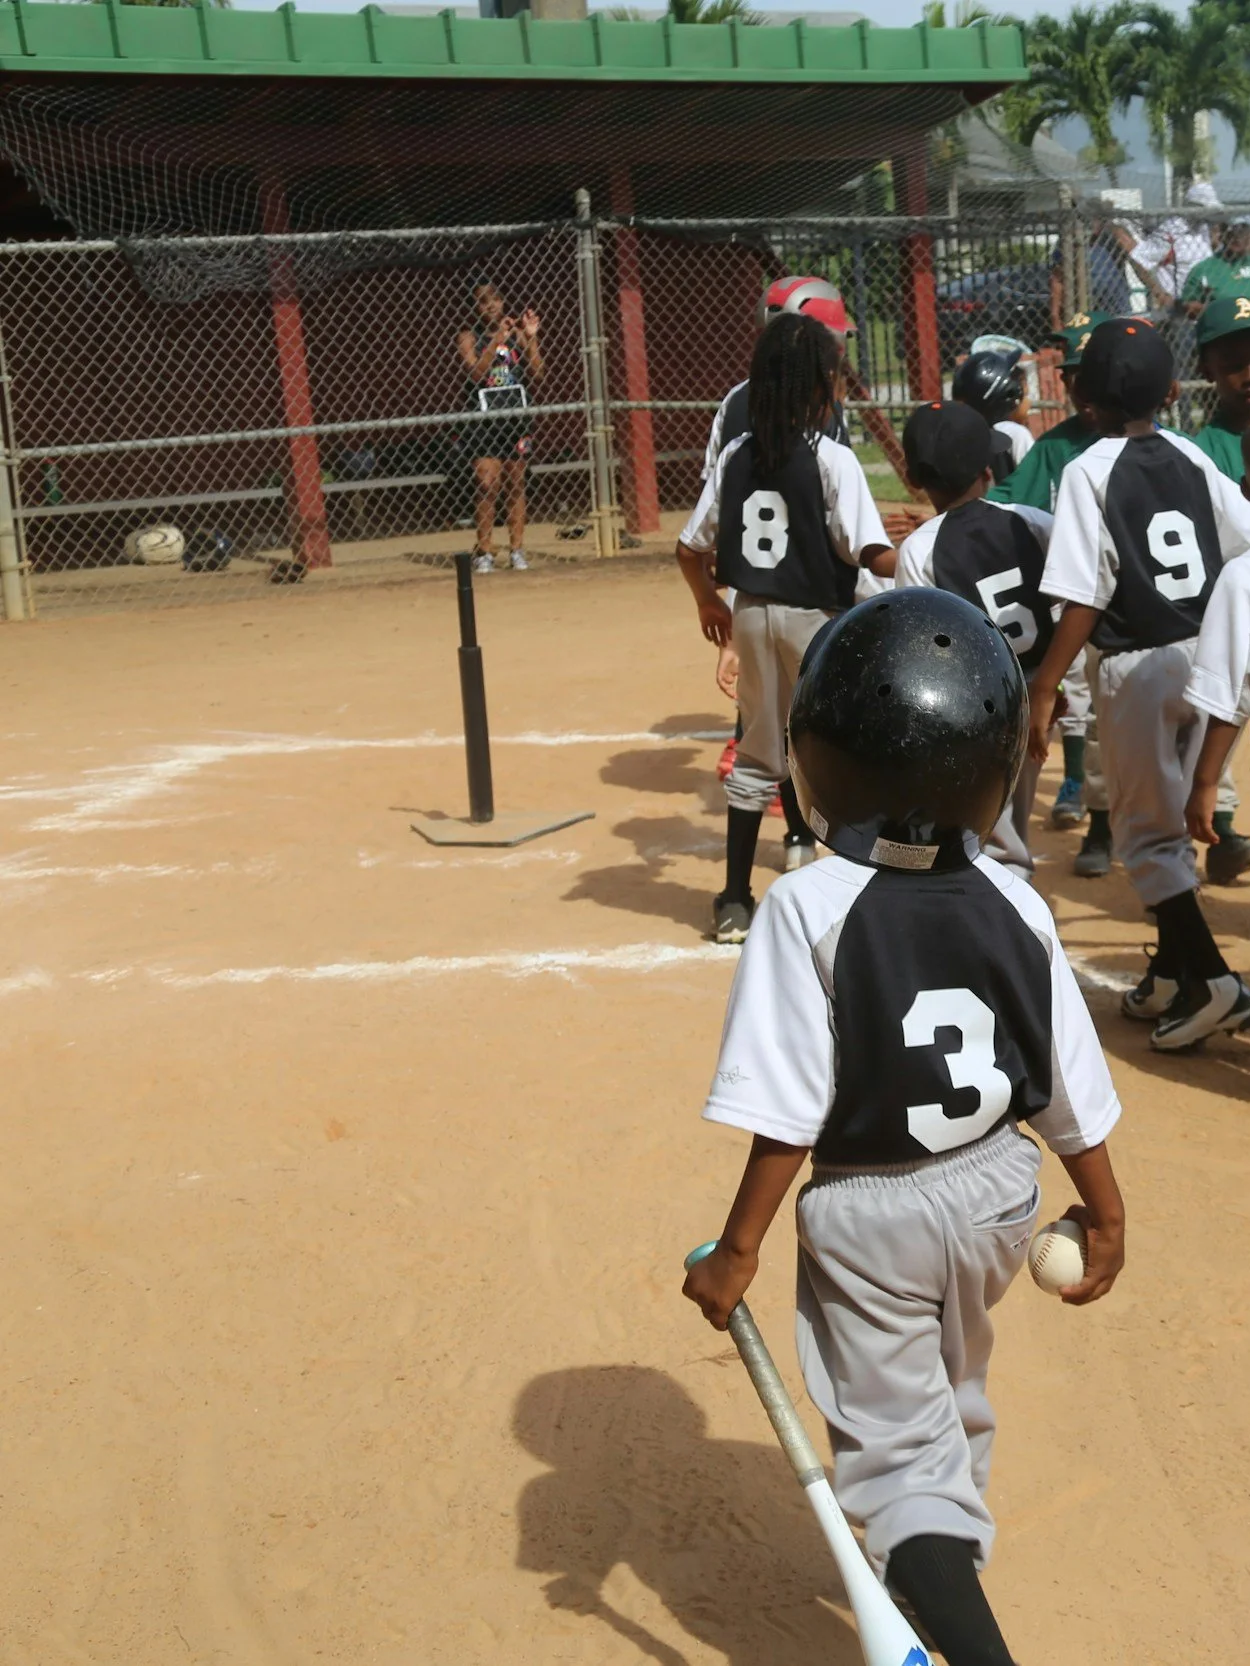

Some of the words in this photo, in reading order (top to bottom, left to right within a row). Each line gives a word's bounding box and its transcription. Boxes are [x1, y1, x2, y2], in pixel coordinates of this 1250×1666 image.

[742, 490, 788, 568] 8
[1147, 510, 1207, 602] 9
[976, 566, 1038, 654] 5
[889, 842, 927, 853] WARNING
[902, 988, 1012, 1154] 3
